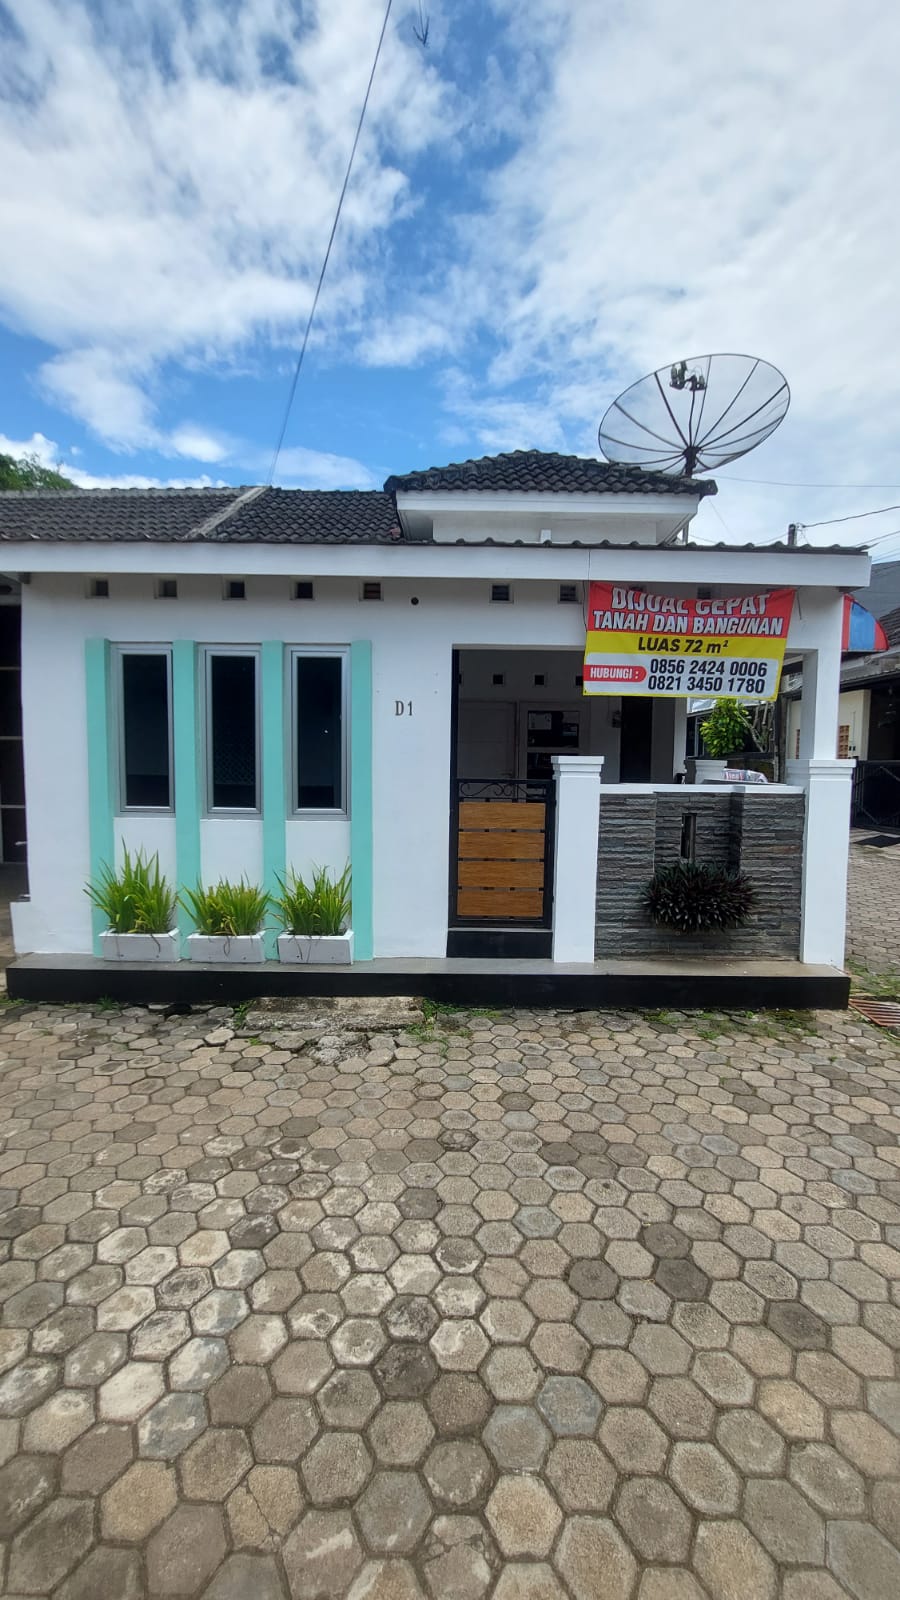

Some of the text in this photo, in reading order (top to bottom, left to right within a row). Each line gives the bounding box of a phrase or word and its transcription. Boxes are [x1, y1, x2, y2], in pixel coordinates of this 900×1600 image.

[593, 611, 783, 635] TANAH DAN BANGUNAN
[638, 637, 680, 652] LUAS
[685, 640, 702, 653] 72
[650, 659, 767, 677] 0856 2424 0006
[648, 675, 765, 693] 0821 3450 1780
